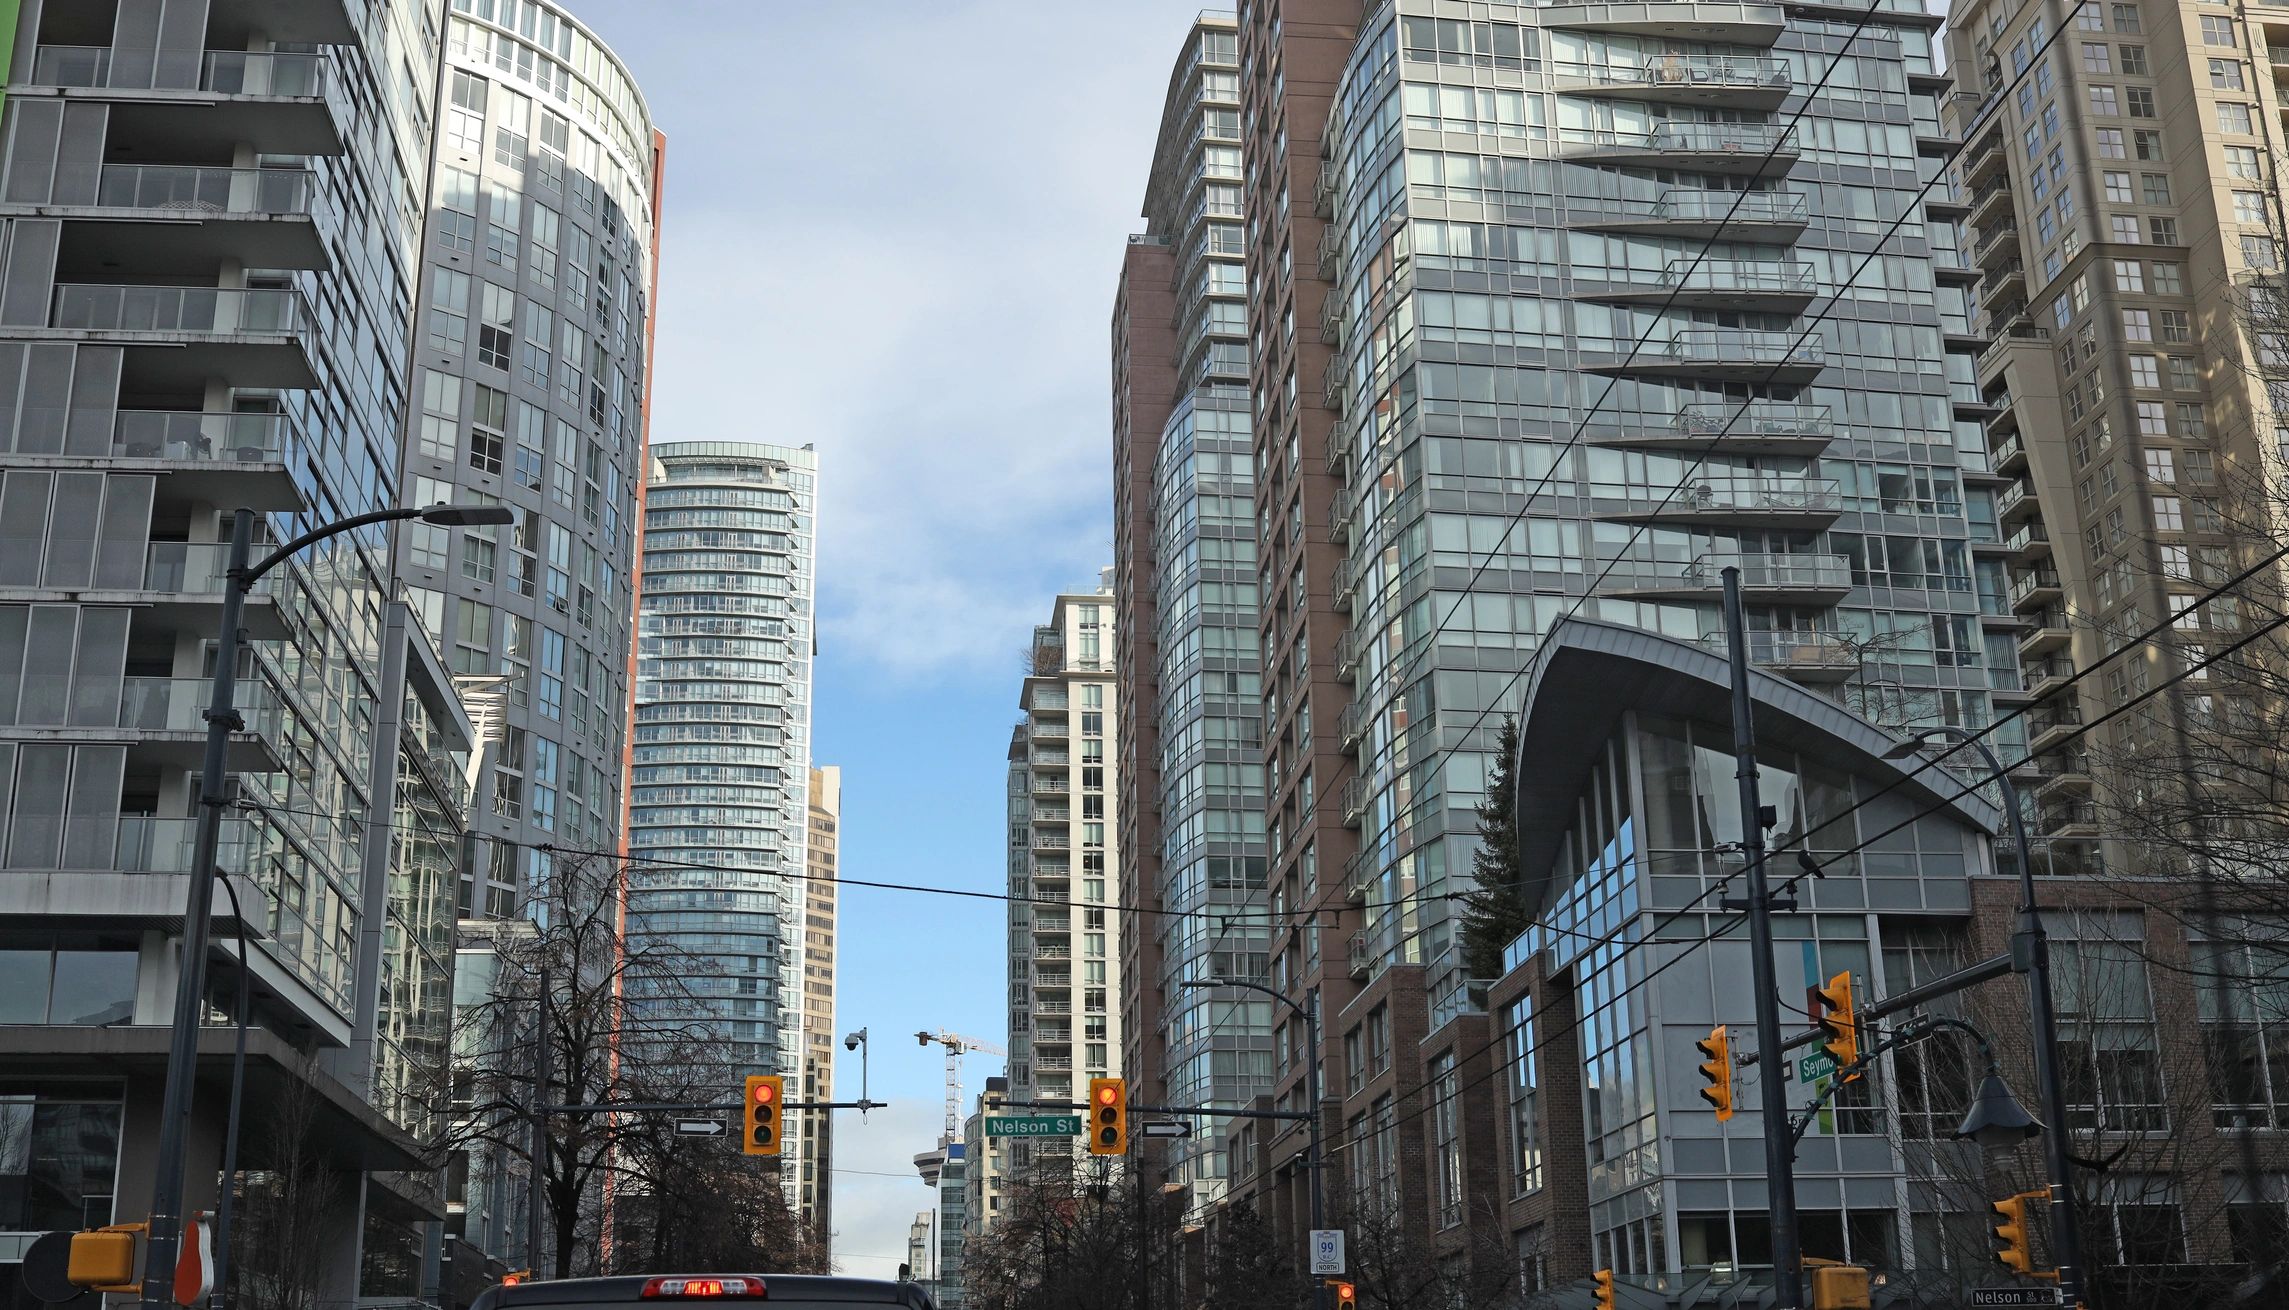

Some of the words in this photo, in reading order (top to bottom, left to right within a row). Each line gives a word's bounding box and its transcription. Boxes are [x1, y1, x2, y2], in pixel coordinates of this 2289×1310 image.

[1803, 1057, 1834, 1077] Seymo
[992, 1120, 1048, 1133] Nelson
[1056, 1119, 1074, 1132] St
[1320, 1242, 1333, 1253] 99
[1975, 1291, 2020, 1304] Nelson
